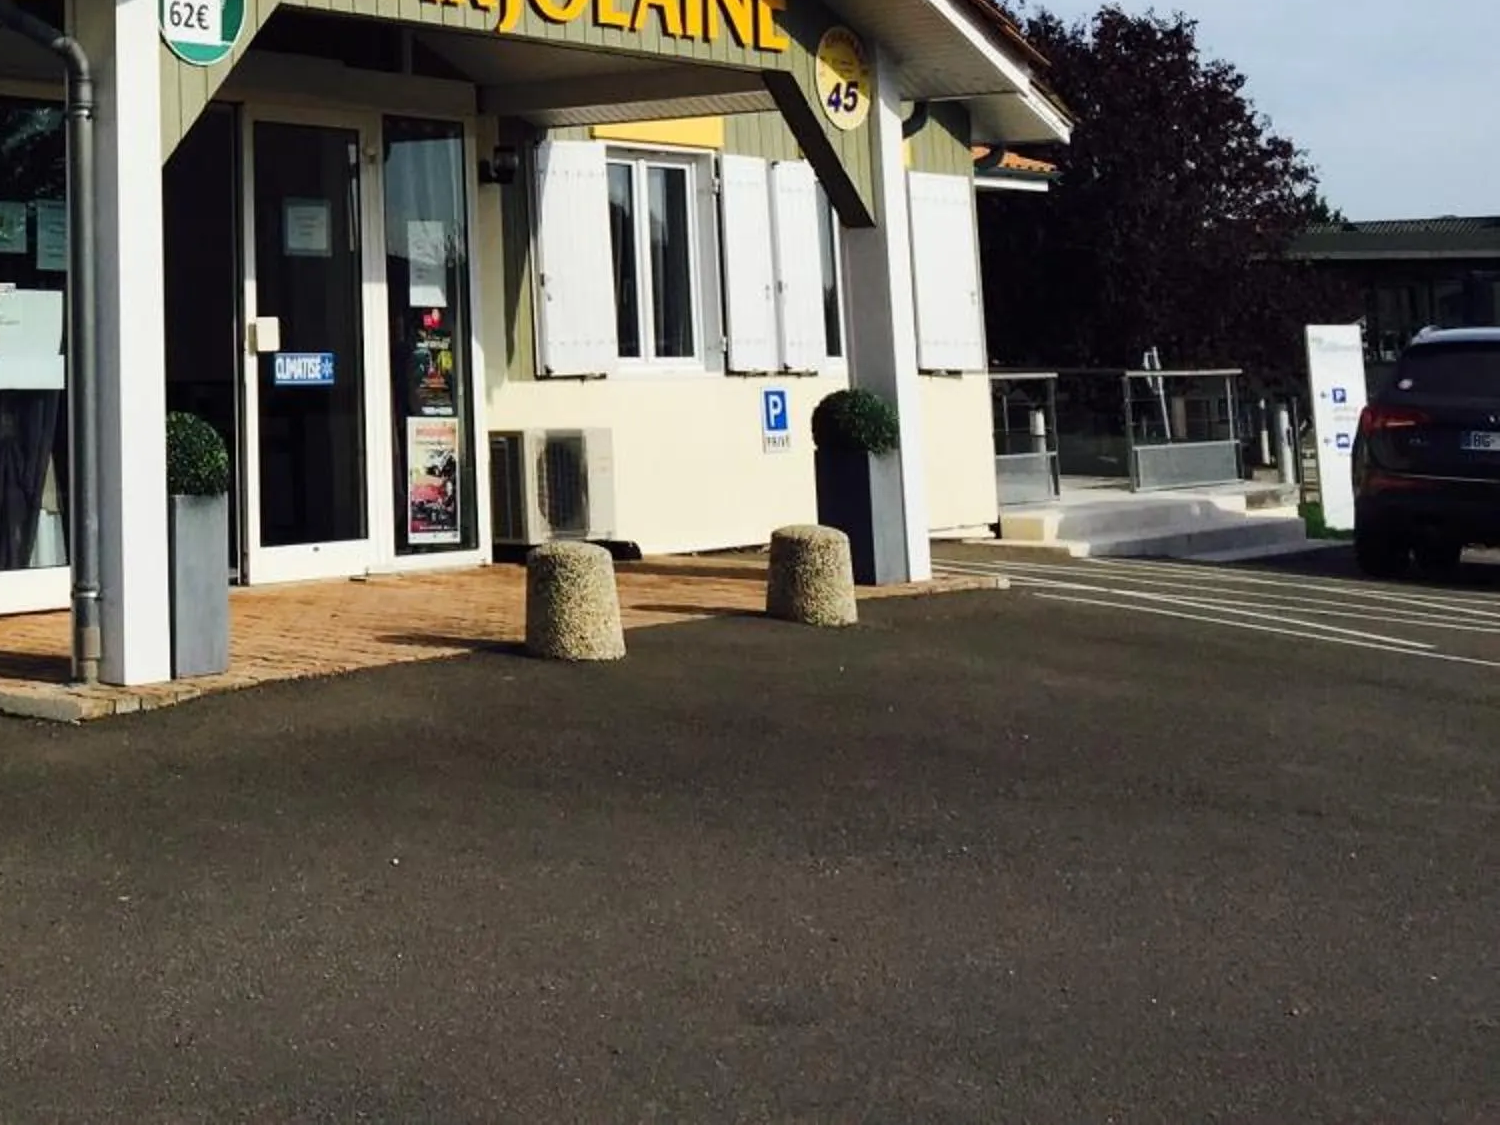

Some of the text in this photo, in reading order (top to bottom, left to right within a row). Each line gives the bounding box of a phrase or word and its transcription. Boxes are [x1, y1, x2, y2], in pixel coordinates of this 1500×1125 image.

[169, 0, 209, 30] 62€
[827, 81, 859, 113] 45
[769, 394, 782, 427] P
